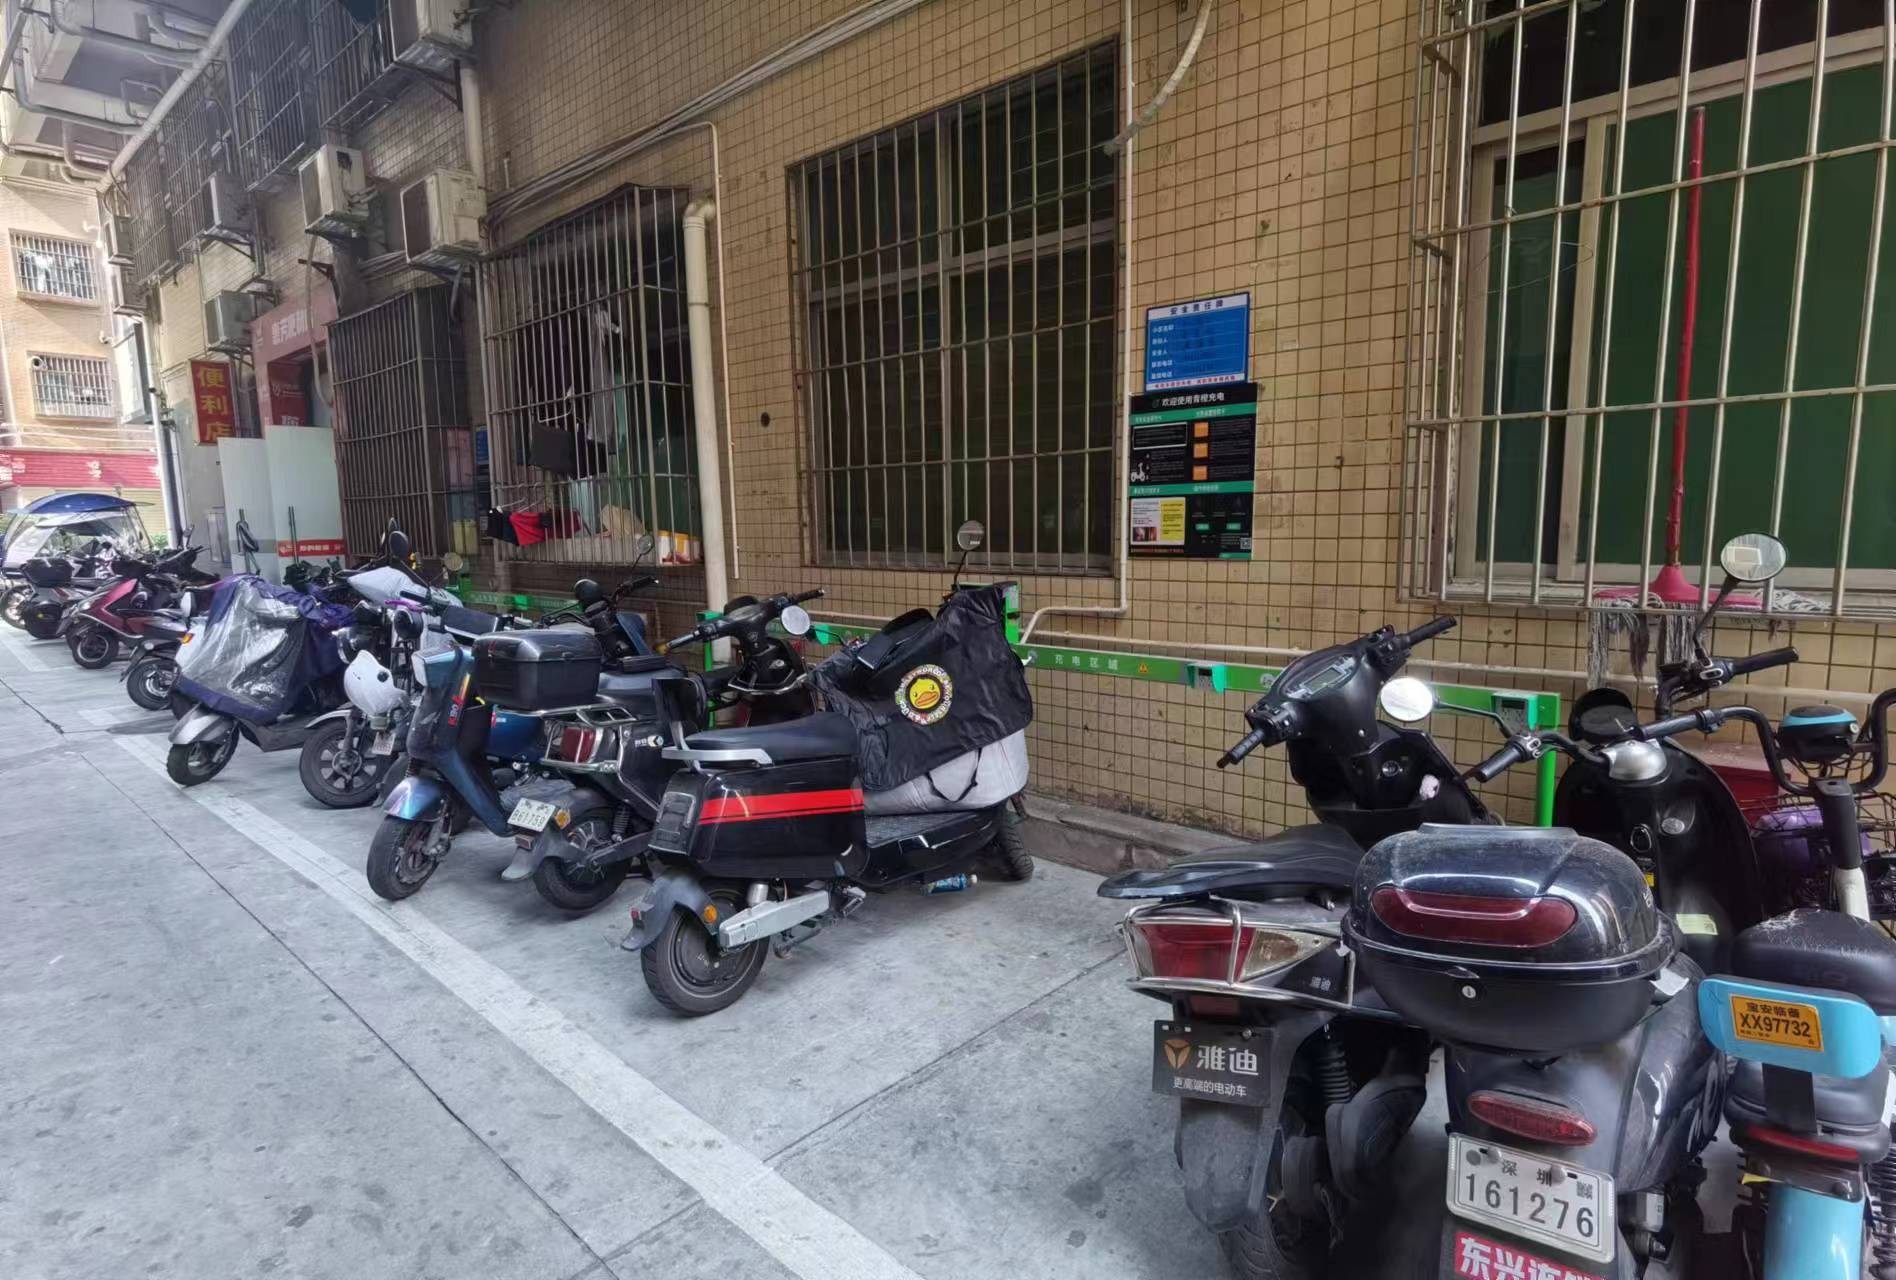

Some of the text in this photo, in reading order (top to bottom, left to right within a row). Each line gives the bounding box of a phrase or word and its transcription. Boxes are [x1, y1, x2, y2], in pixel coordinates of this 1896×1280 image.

[200, 367, 232, 441] 便利店
[1739, 1013, 1811, 1038] XX97732
[1196, 1044, 1259, 1076] 雅迪
[1173, 1075, 1247, 1097] 更高端的电动车
[1465, 1173, 1595, 1238] 161276
